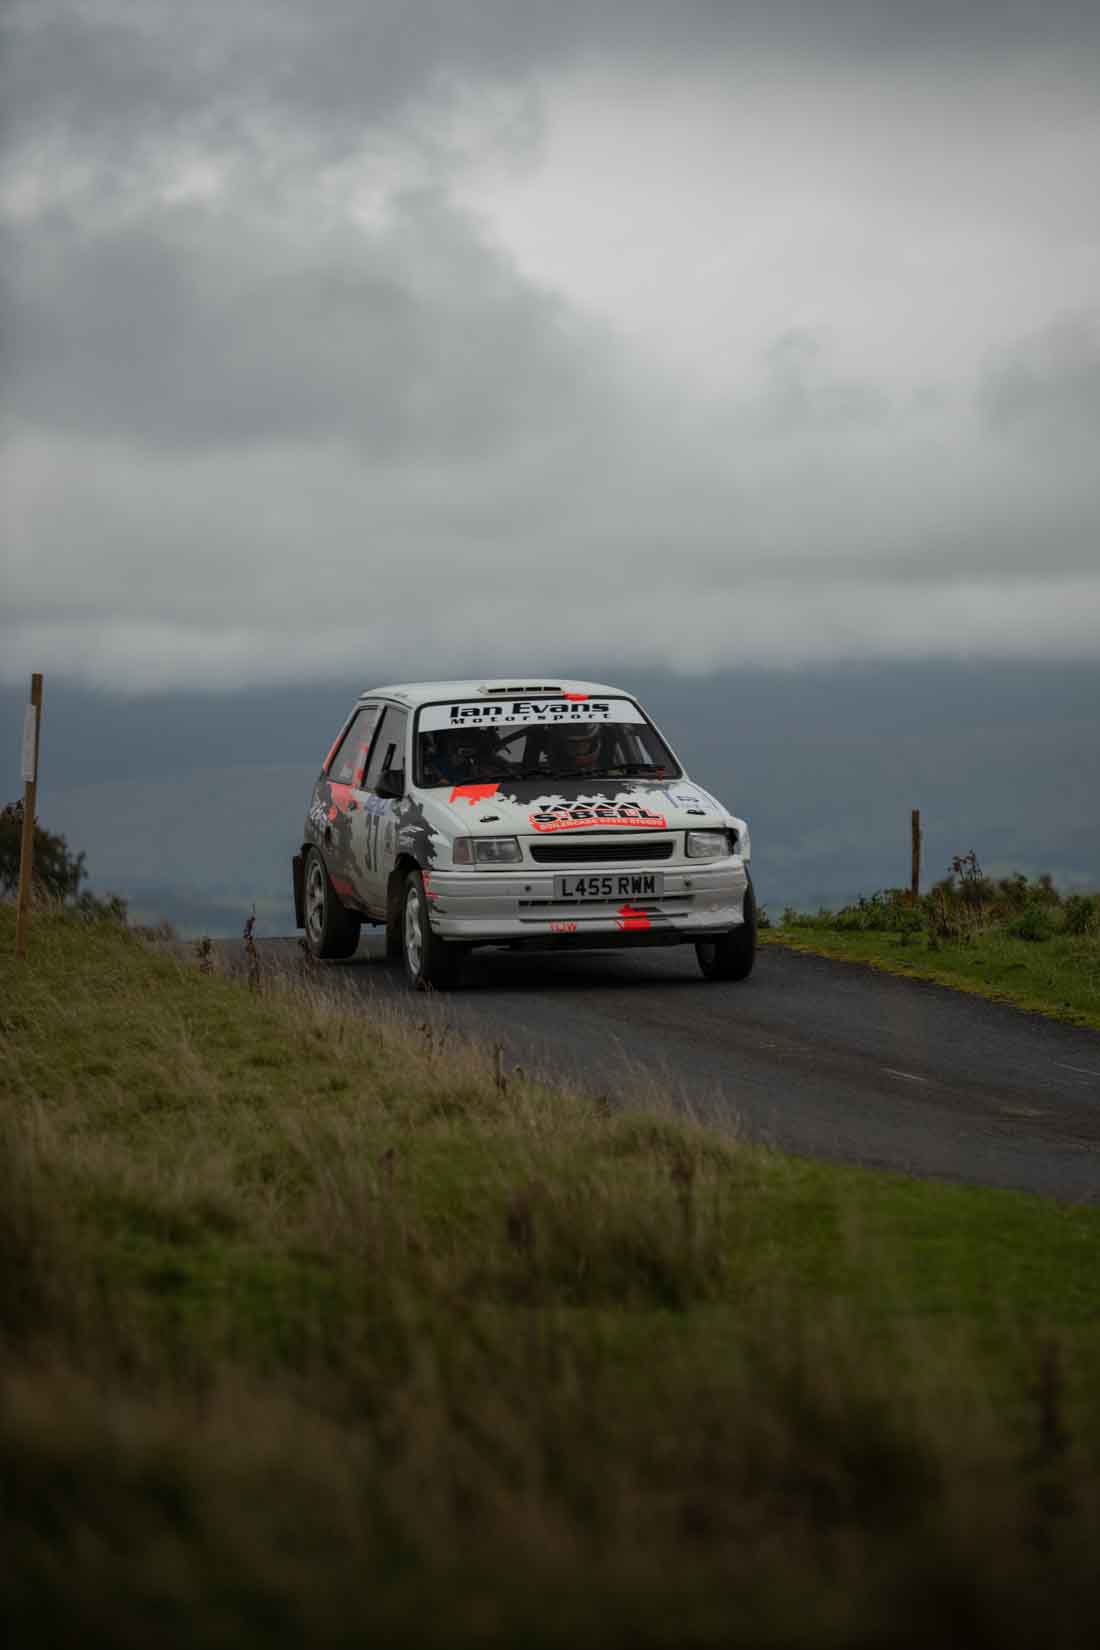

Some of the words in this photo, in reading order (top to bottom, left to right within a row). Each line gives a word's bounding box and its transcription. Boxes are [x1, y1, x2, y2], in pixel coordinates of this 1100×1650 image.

[450, 704, 503, 718] Ian
[512, 701, 609, 715] Evans
[450, 712, 609, 725] Motorsport
[561, 878, 613, 897] L455
[618, 876, 656, 895] RWM
